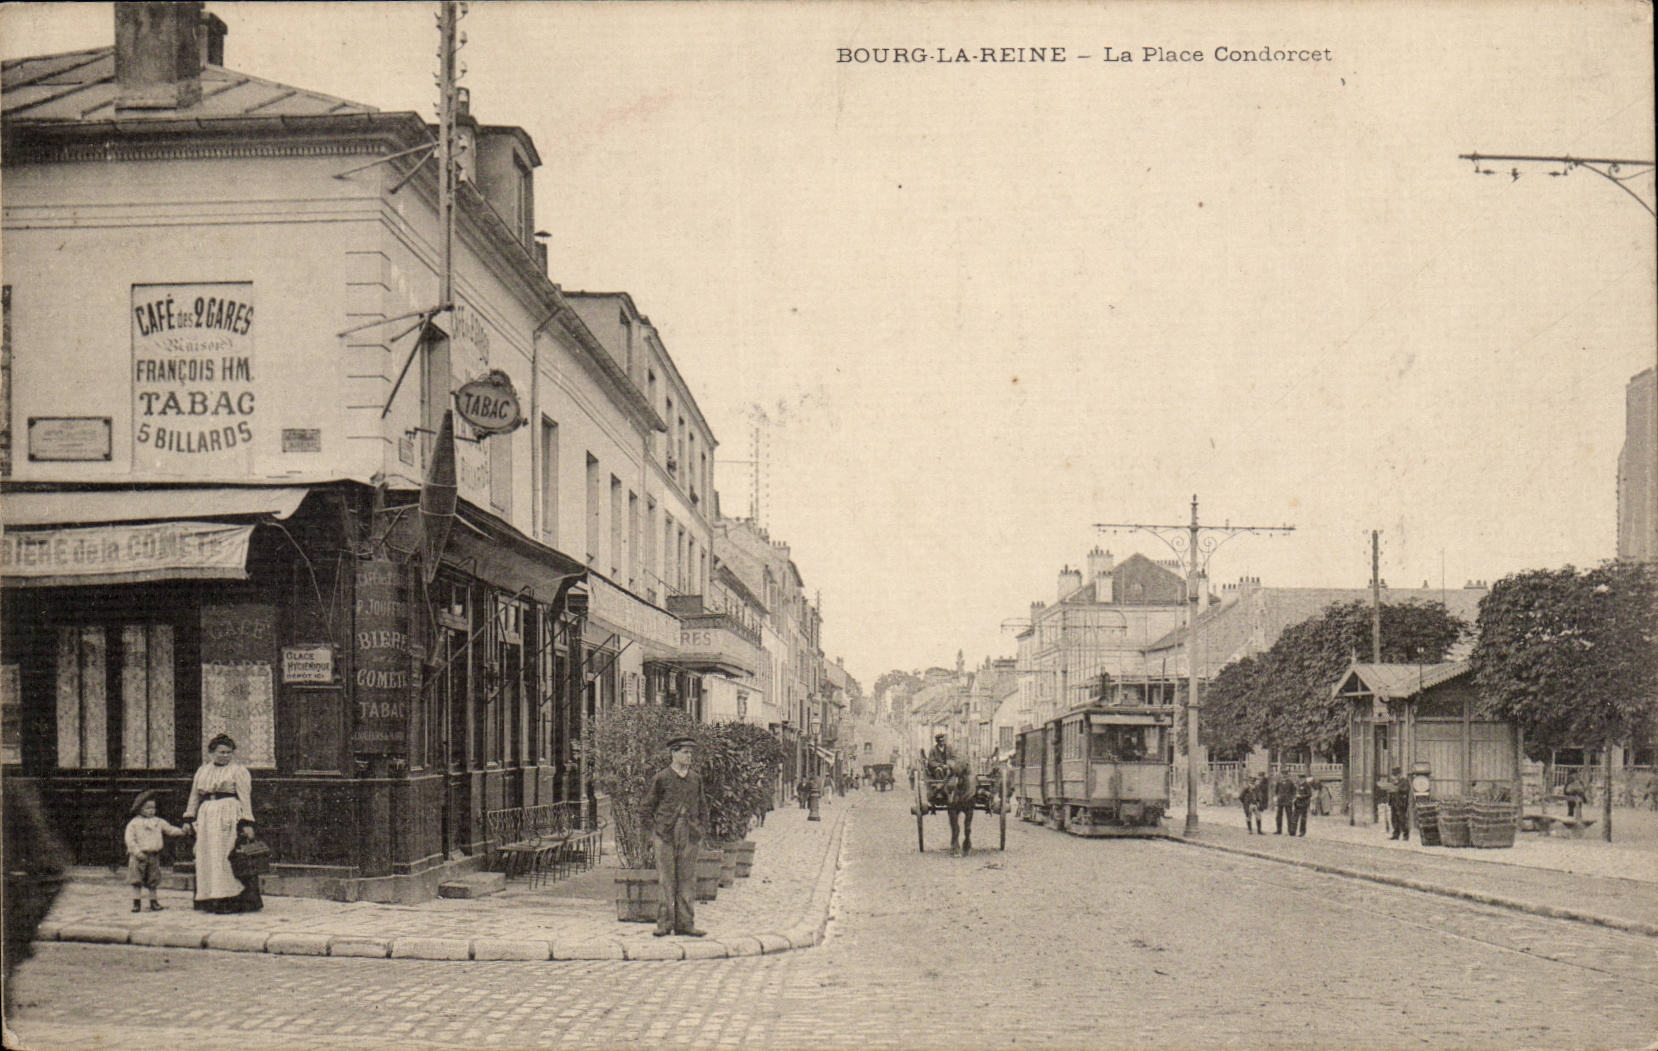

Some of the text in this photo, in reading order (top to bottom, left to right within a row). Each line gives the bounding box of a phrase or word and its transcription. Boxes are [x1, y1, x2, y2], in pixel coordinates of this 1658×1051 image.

[135, 293, 254, 336] CAFÉ des 2 GARES
[136, 358, 214, 386] FRANÇOIS
[139, 390, 255, 416] TABAC
[465, 391, 510, 420] TABAC
[137, 423, 151, 443] 5
[155, 420, 252, 453] BILLARDS
